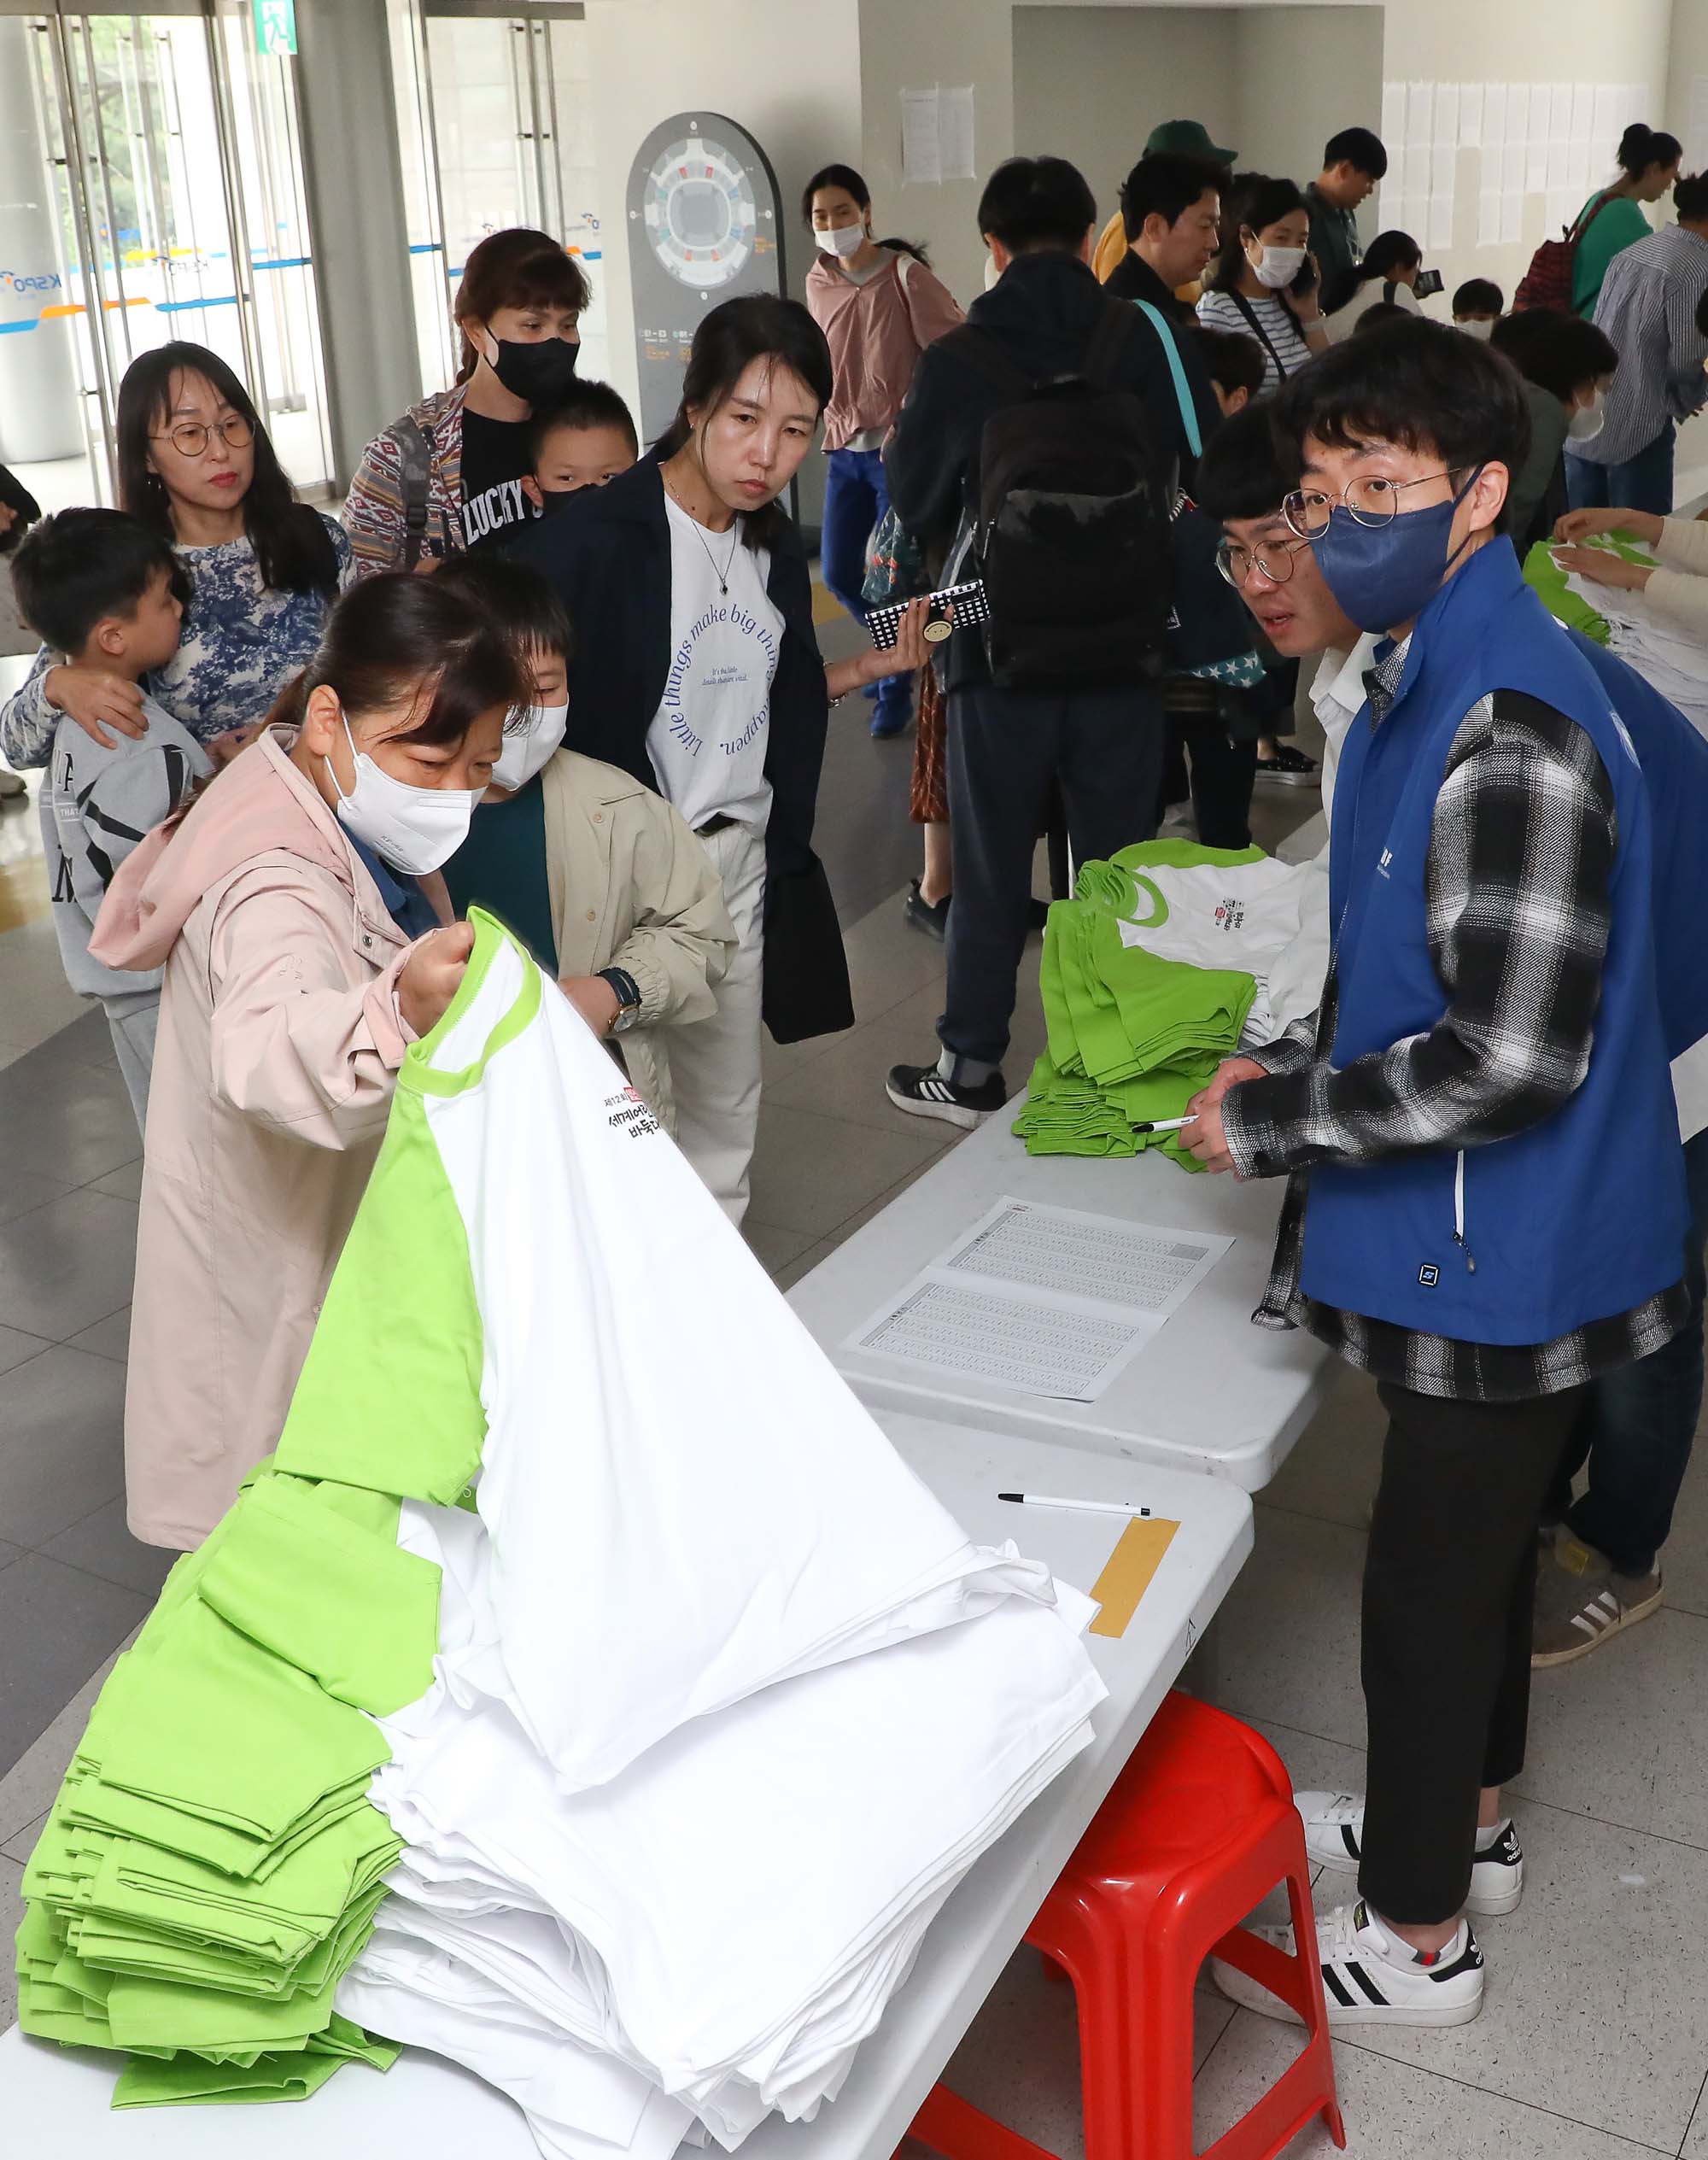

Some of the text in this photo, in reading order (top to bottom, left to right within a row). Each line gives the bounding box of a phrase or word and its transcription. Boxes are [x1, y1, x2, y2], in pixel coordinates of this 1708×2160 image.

[462, 479, 525, 545] LUCKY
[690, 604, 727, 641] make
[730, 604, 757, 635] big
[663, 640, 693, 707] things
[669, 712, 704, 757] Little
